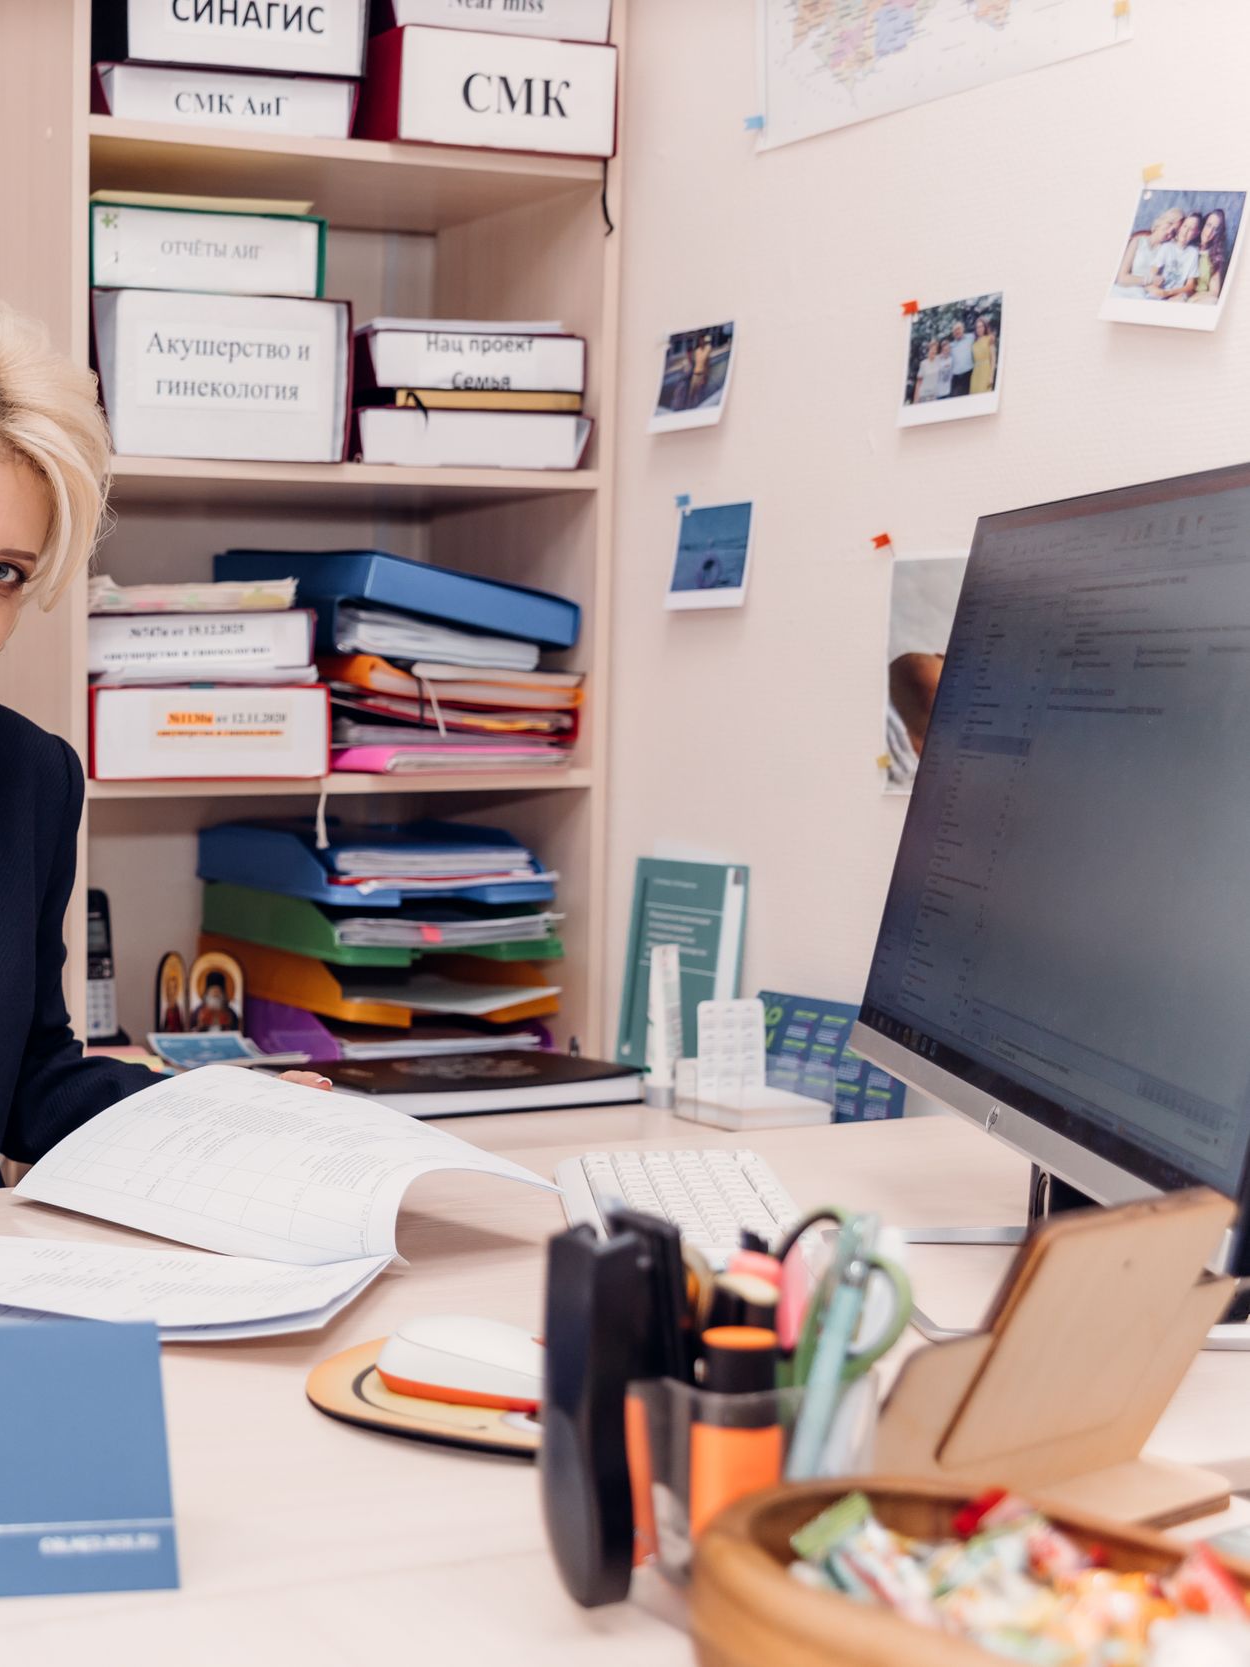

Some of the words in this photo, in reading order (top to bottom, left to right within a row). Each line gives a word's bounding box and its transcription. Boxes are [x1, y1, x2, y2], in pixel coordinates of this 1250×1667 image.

[172, 0, 325, 34] СИНАГИС
[174, 92, 234, 115] СМК
[462, 72, 570, 118] СМК
[160, 238, 228, 259] ОТЧЁТЫ
[146, 331, 291, 363] Акушерство
[297, 344, 310, 361] и
[426, 332, 464, 354] Нац
[469, 336, 533, 356] проект
[155, 379, 300, 401] гинекология
[451, 371, 511, 390] Семья
